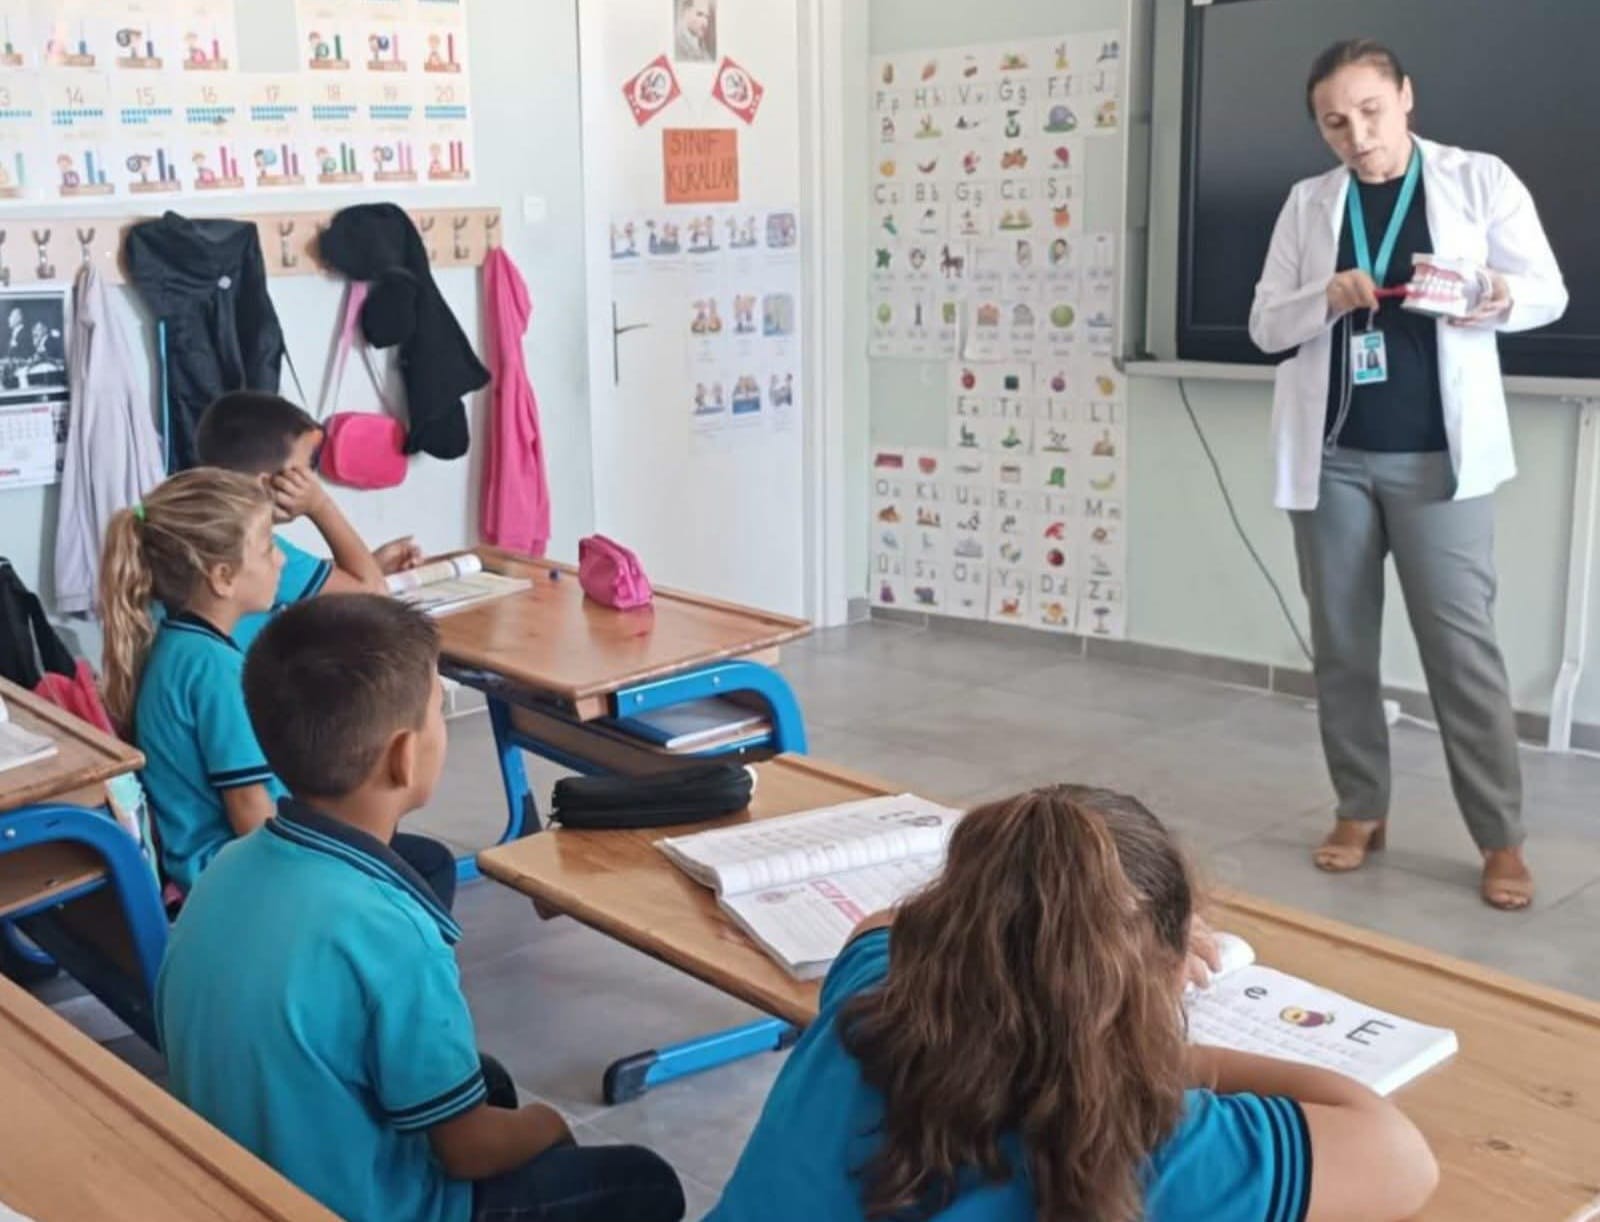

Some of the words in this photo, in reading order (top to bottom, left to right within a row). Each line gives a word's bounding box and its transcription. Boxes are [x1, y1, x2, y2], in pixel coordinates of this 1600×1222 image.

[65, 85, 85, 106] 14
[135, 86, 155, 106] 15
[1244, 986, 1268, 1000] e
[1346, 1019, 1395, 1046] E
